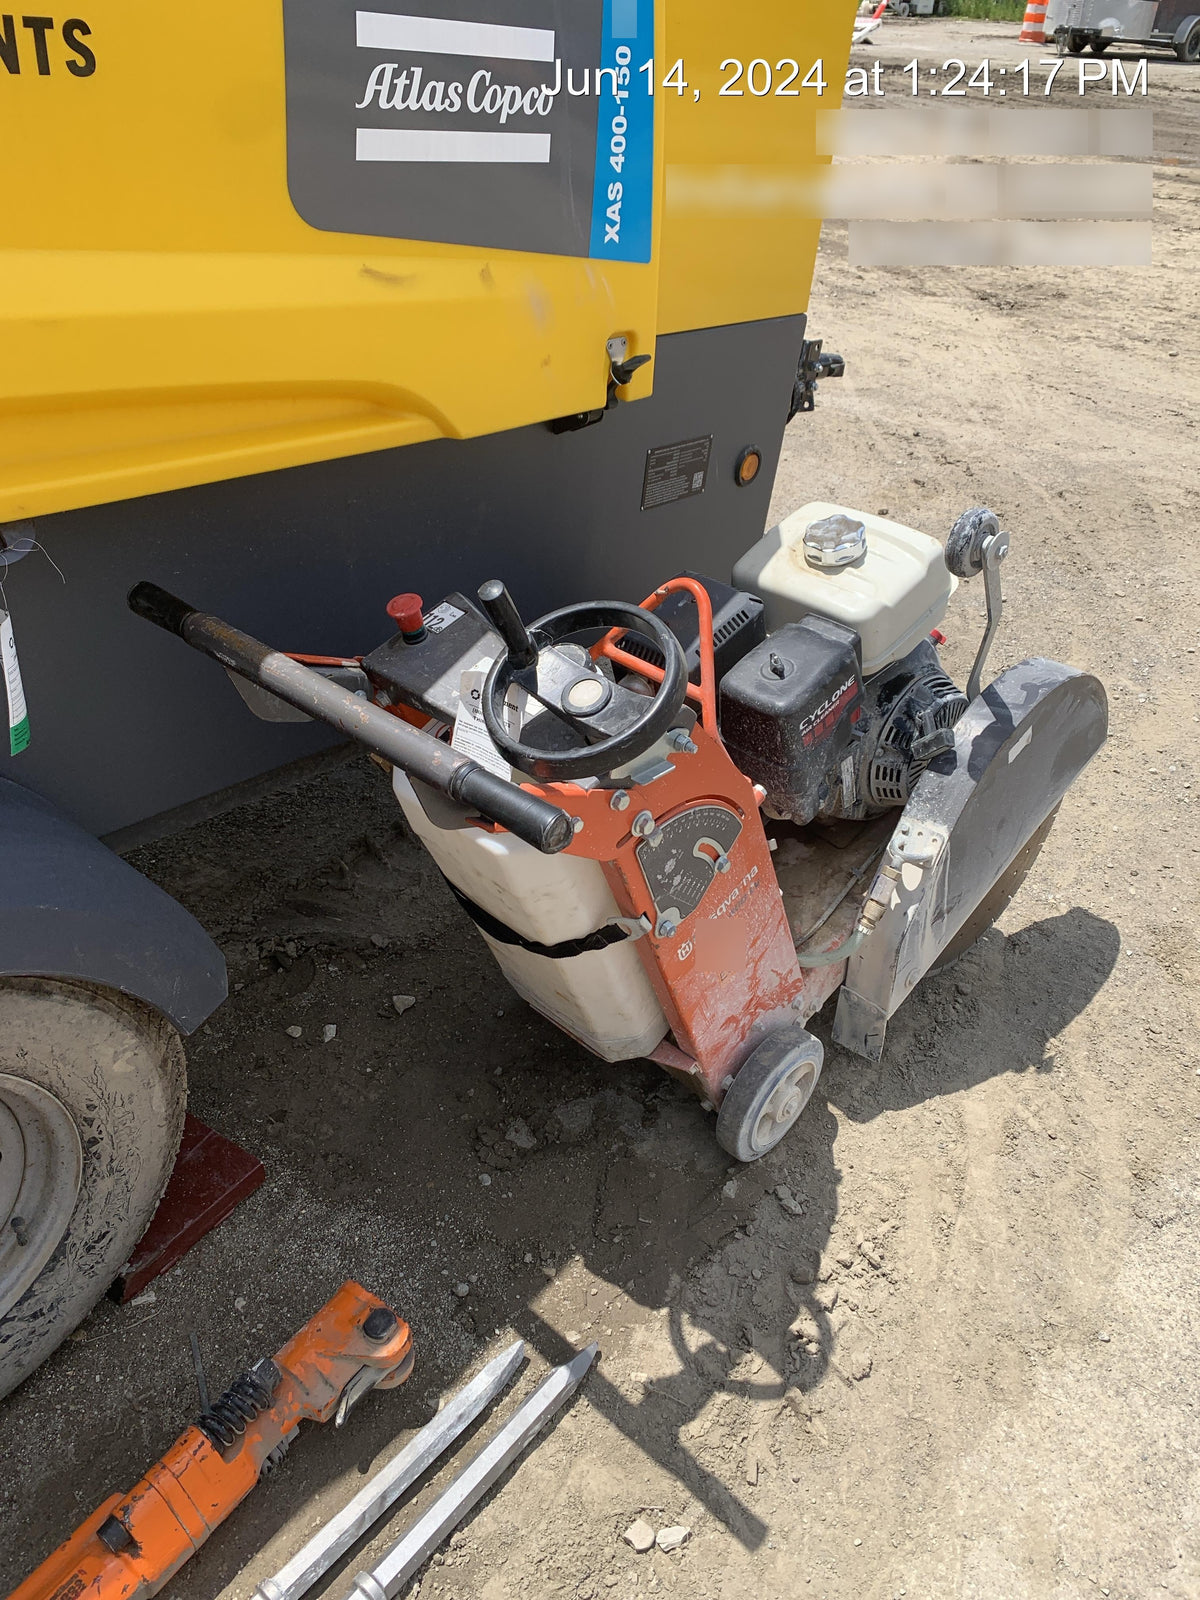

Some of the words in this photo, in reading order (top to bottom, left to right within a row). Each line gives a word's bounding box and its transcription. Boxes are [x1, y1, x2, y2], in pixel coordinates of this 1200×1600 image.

[0, 14, 97, 78] NTS
[355, 63, 463, 113] Atlas
[466, 70, 554, 124] Copco
[610, 45, 632, 173] 400-150
[604, 181, 624, 244] XAS
[799, 674, 856, 730] CYCLONE
